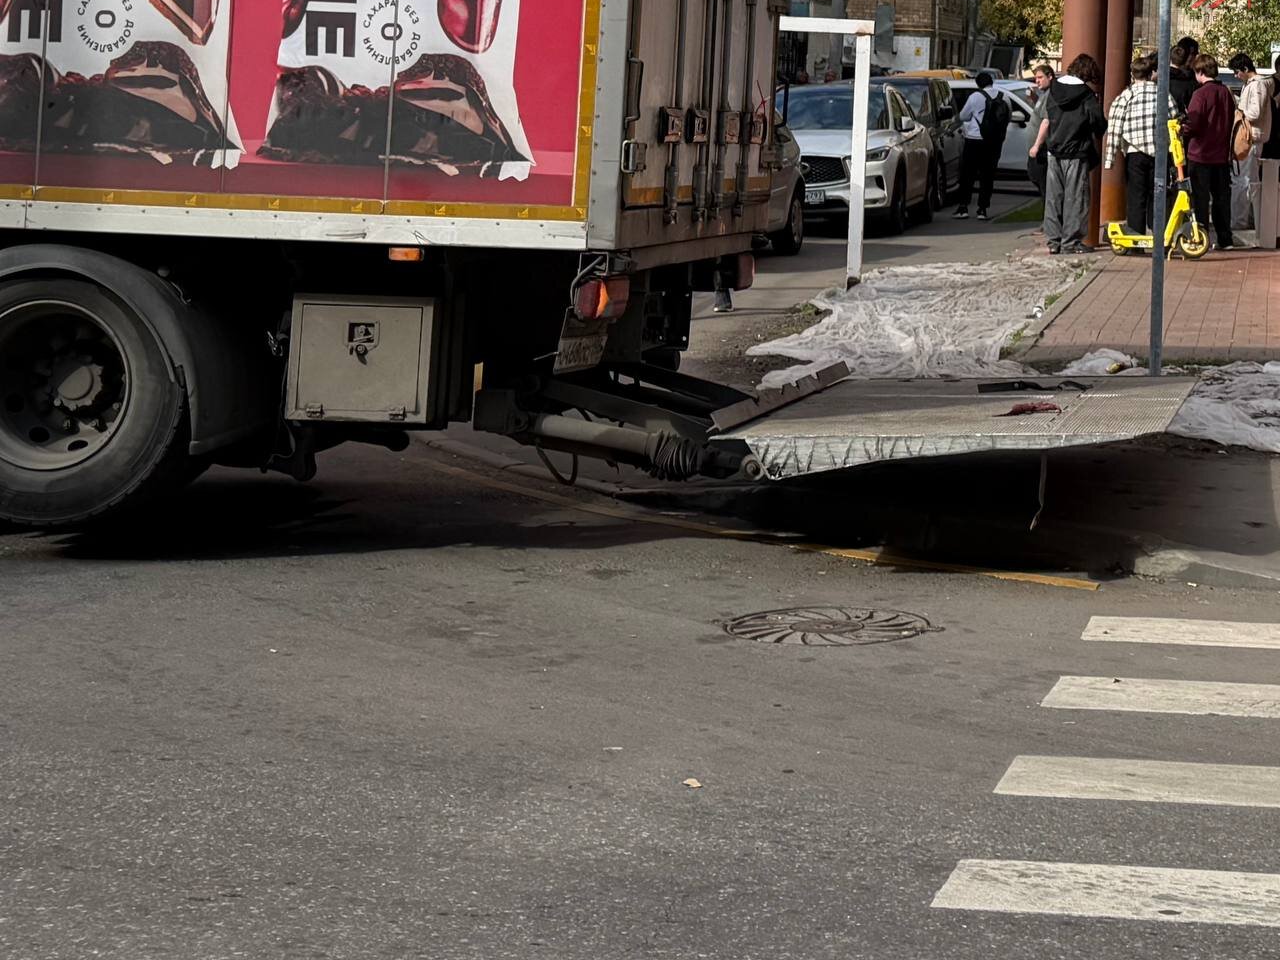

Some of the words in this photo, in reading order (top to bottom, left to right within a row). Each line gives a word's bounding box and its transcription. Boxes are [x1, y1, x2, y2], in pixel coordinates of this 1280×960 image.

[404, 4, 420, 25] БЕЗ
[77, 19, 134, 53] ДОБАВЛЕНИЯ
[363, 32, 421, 65] ДОБАВЛЕНИЯ
